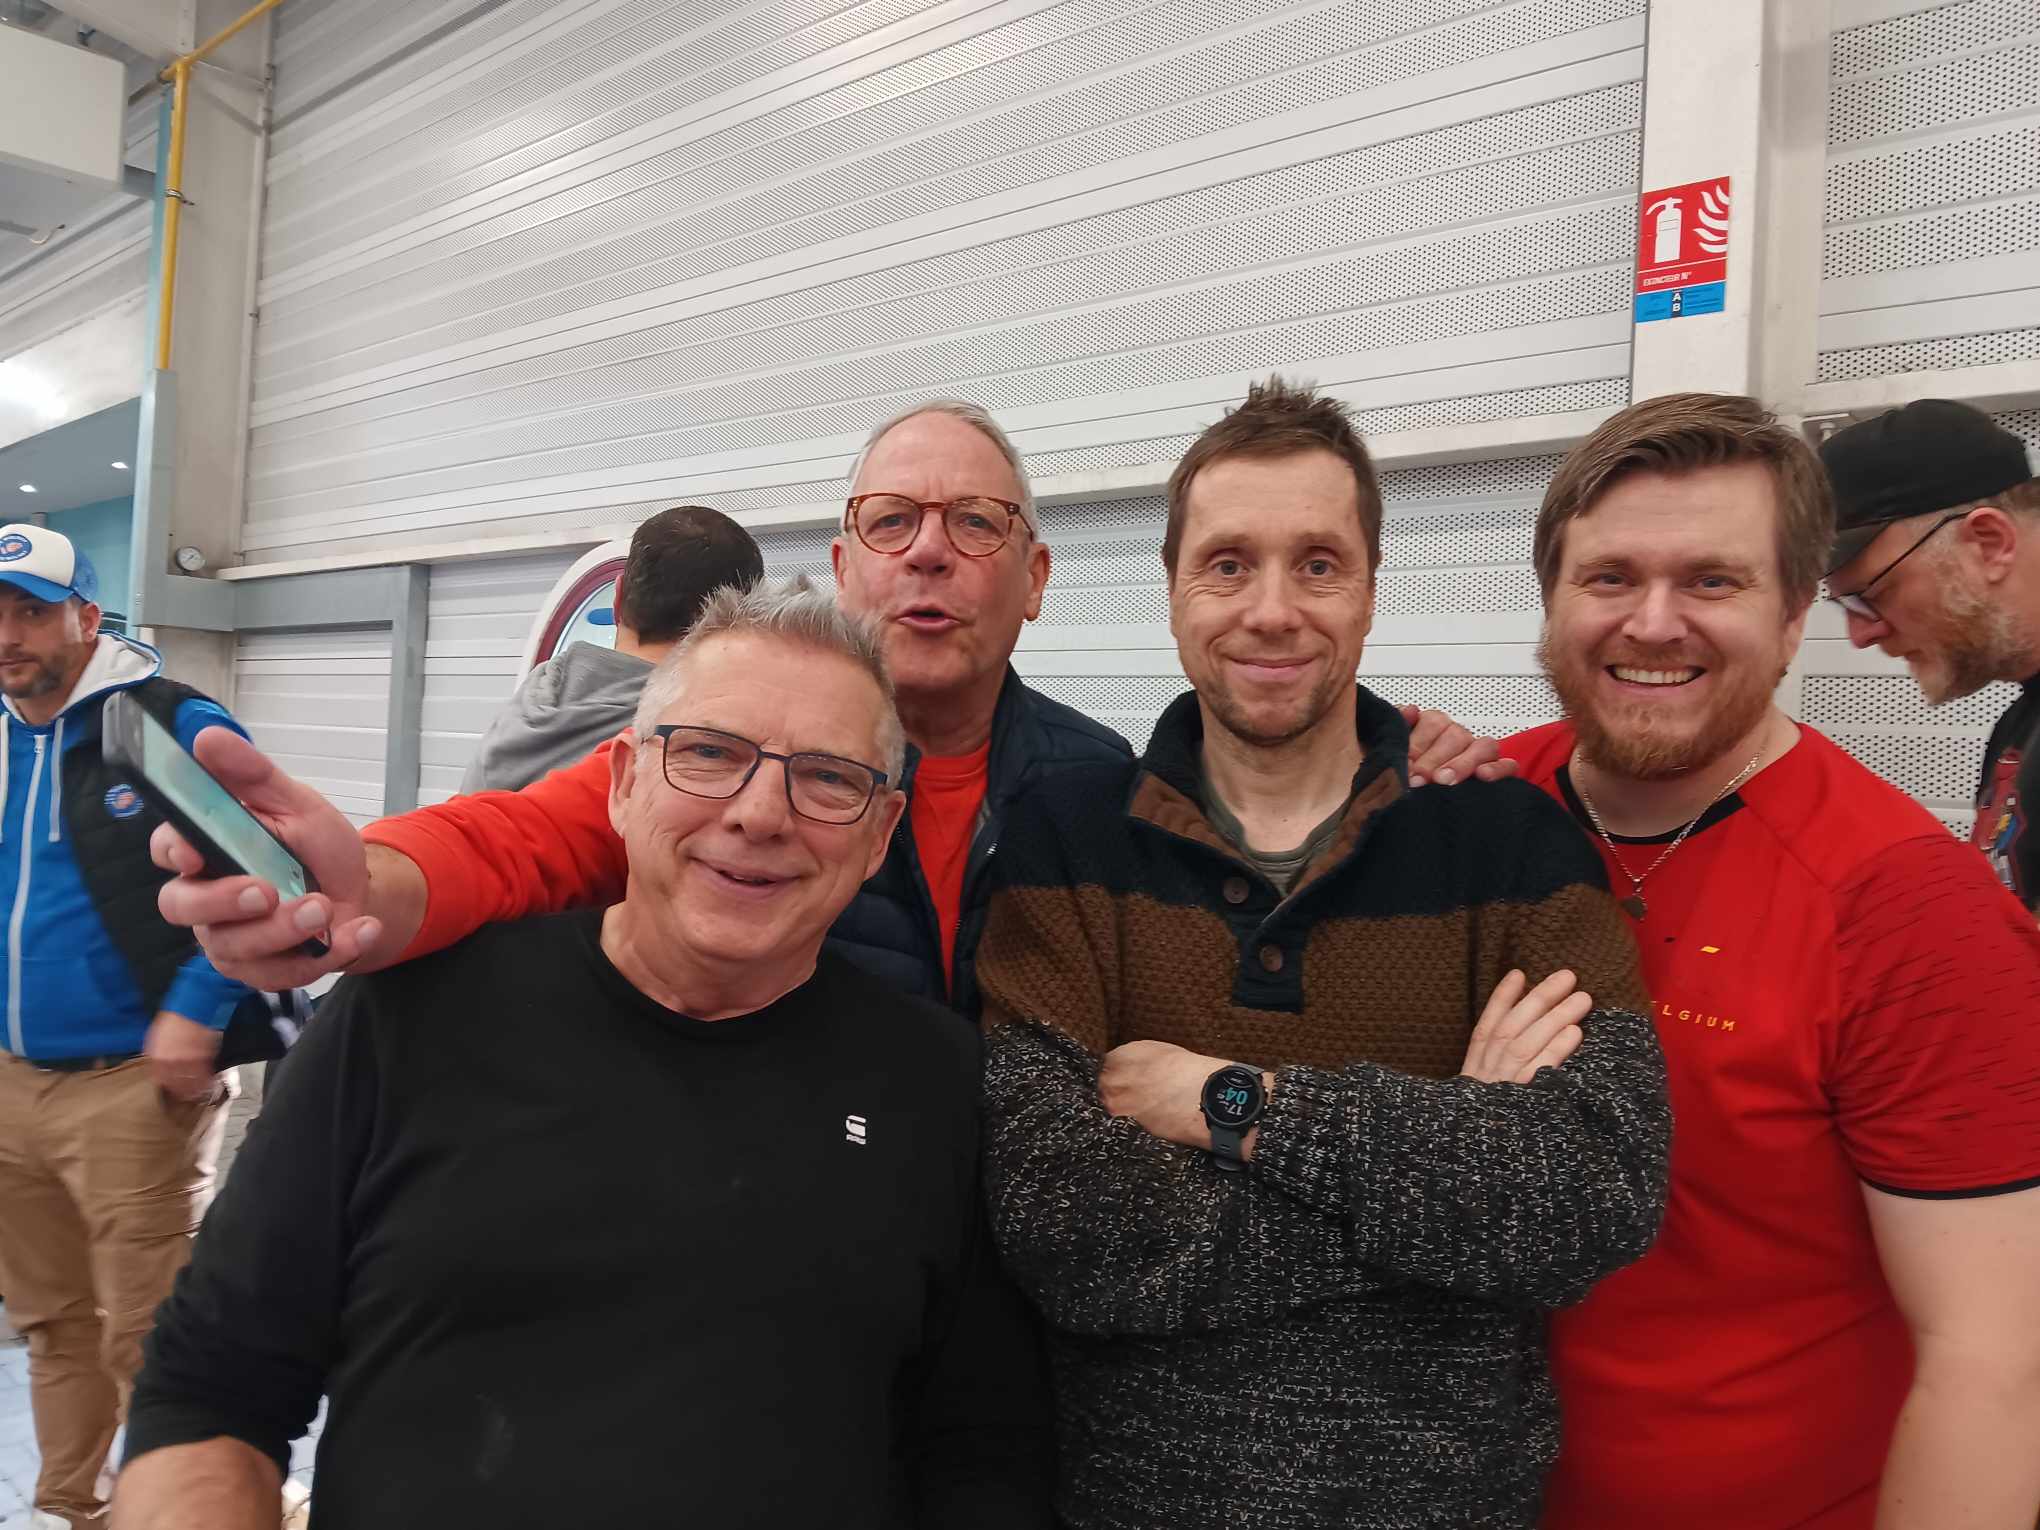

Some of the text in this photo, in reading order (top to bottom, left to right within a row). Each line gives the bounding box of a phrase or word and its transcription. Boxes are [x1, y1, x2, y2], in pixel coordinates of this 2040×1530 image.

[1672, 293, 1681, 302] A
[1672, 303, 1681, 312] B
[1225, 1087, 1248, 1105] 04
